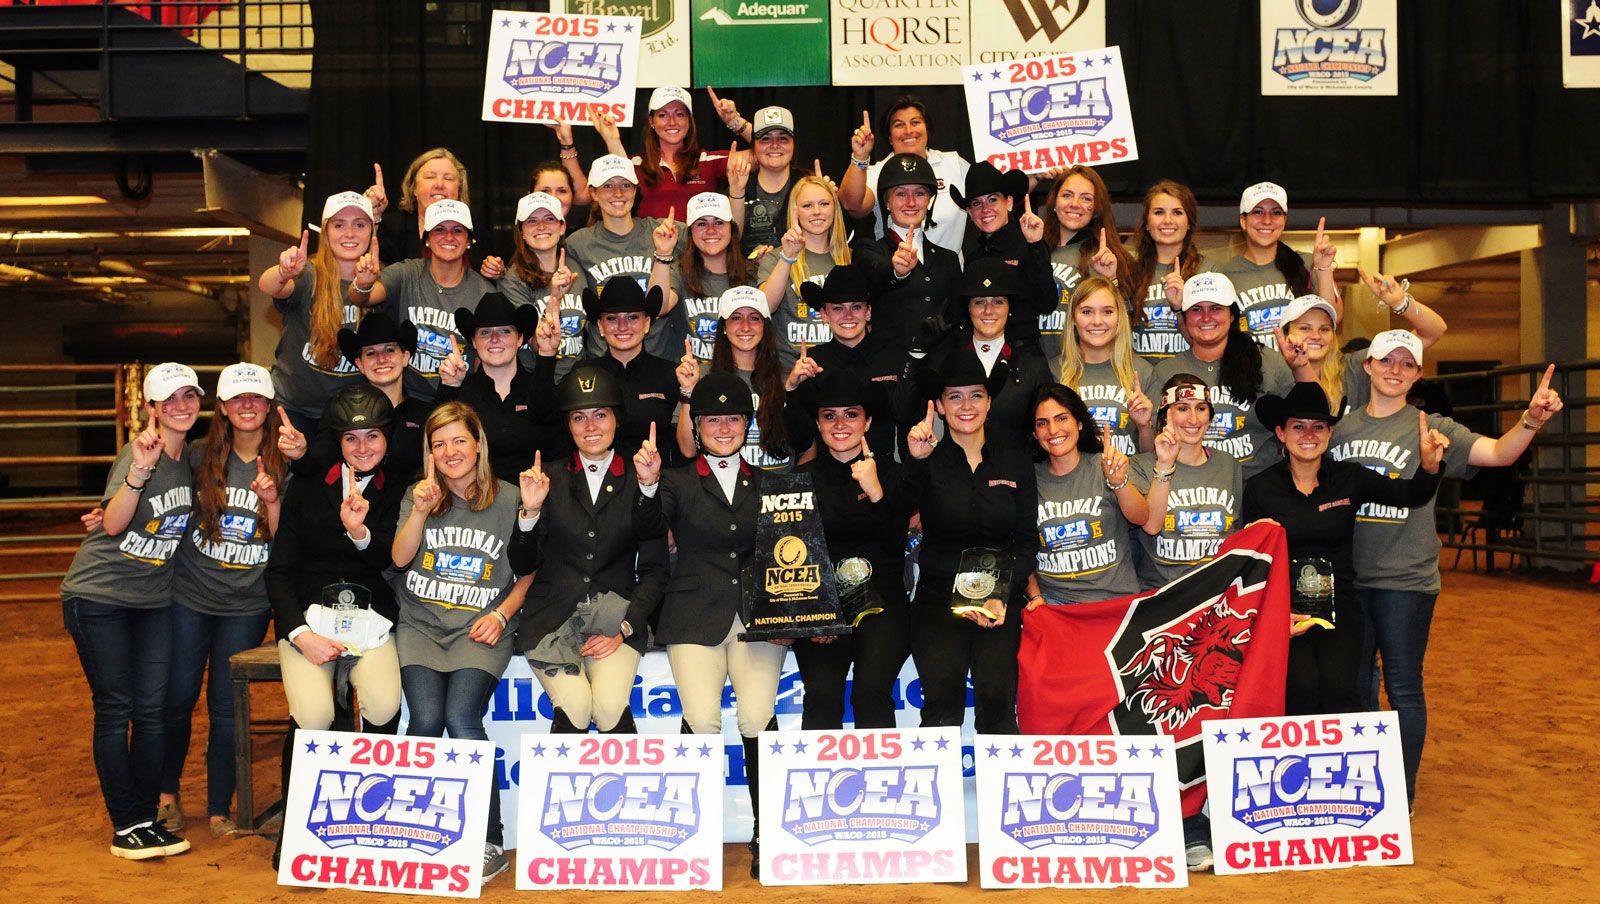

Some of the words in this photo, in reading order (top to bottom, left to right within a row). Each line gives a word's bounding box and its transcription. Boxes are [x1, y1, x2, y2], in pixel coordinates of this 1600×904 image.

[535, 16, 599, 37] 2015
[647, 33, 679, 55] Ltd.
[980, 51, 1019, 63] CITY
[1273, 29, 1385, 67] NCEA
[504, 40, 622, 81] NCEA
[843, 54, 961, 67] ASSOCIATION
[1008, 57, 1077, 83] 2015
[519, 77, 552, 85] NATIONAL
[552, 78, 604, 88] CHAMPIONSHIP
[492, 98, 626, 123] CHAMPS
[990, 79, 1110, 131] NCEA
[1007, 123, 1041, 136] NATIONAL
[1042, 118, 1097, 129] CHAMPIONSHIP
[987, 138, 1128, 173] CHAMPS
[588, 256, 652, 284] NATIONA
[685, 297, 719, 317] NATI
[1233, 284, 1295, 314] NATIONA
[408, 306, 465, 338] NATION
[698, 319, 718, 333] NC
[558, 336, 583, 355] PIONS
[1132, 331, 1190, 353] CHAMPION
[1078, 385, 1127, 407] TIONA
[1331, 440, 1411, 470] NATIONAL
[149, 486, 192, 518] NATION
[761, 491, 814, 514] NCEA
[1356, 502, 1409, 519] PIONS
[219, 514, 255, 534] CEA
[773, 511, 803, 523] 2015
[1177, 511, 1222, 526] NCEA
[426, 526, 504, 560] NATIONAL
[1044, 520, 1089, 542] NCEA
[119, 531, 180, 560] CHAMPI
[192, 529, 269, 565] CAMPIONS
[1157, 535, 1227, 561] CHAMPIO
[422, 552, 435, 570] 20
[436, 552, 483, 574] NCEA
[767, 566, 818, 586] NCEA
[406, 570, 500, 609] CHAMPIONS
[755, 616, 794, 625] NATIONAL
[795, 613, 836, 622] CHAMPION
[817, 733, 903, 761] 2015
[1259, 719, 1343, 749] 2015
[350, 737, 436, 769] 2015
[579, 738, 665, 765] 2015
[1033, 740, 1118, 766] 2015
[784, 766, 939, 822] NCEA
[1235, 752, 1381, 811] NCEA
[309, 771, 466, 833] NCEA
[543, 773, 698, 826] NCEA
[1003, 773, 1156, 825] NCEA
[1253, 806, 1296, 821] NATIONAL
[1297, 803, 1364, 816] CHAMPIONSHIP
[327, 824, 371, 836] NATIONAL
[372, 824, 441, 842] CHAMPIONSHIP
[562, 824, 606, 837] NATIONAL
[608, 823, 677, 836] CHAMPIONSHIP
[803, 818, 848, 832] NATIONAL
[849, 817, 920, 830] CHAMPIONSHIP
[1022, 823, 1067, 836] NATIONAL
[1068, 822, 1139, 835] CHAMPIONSHIP
[1225, 833, 1401, 870] CHAMPS
[291, 854, 471, 893] CHAMPS
[528, 857, 710, 885] CHAMPS
[771, 849, 955, 881] CHAMPS
[992, 856, 1175, 884] CHAMPS
